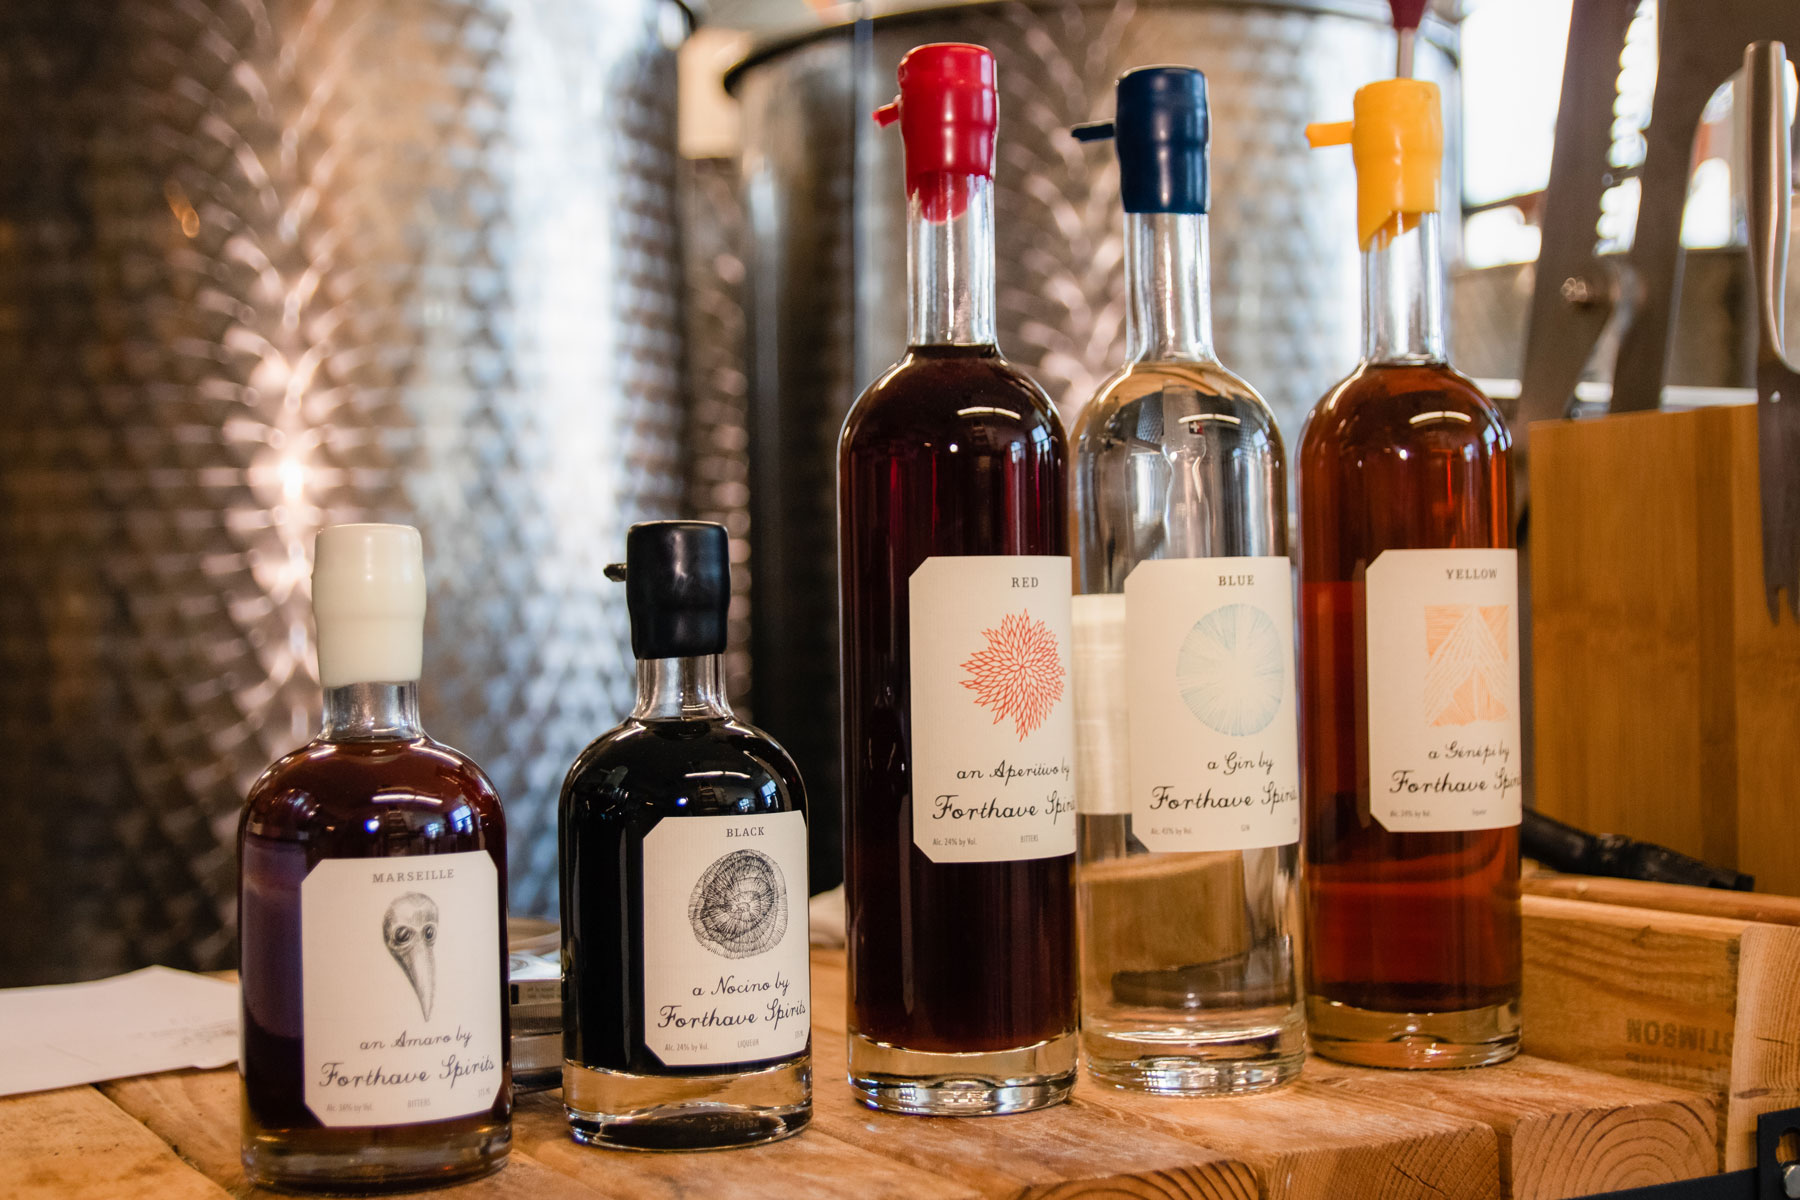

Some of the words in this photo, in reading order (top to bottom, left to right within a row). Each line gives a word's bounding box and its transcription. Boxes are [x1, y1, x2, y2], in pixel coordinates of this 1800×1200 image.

[1011, 576, 1039, 588] RED
[1218, 575, 1255, 587] BLUE
[1446, 568, 1498, 580] YELLOW
[1207, 759, 1219, 771] a
[1223, 751, 1255, 775] Gin
[1258, 751, 1274, 774] by
[1428, 750, 1439, 760] a
[1499, 739, 1510, 763] by
[956, 767, 984, 780] an
[989, 760, 1059, 786] Aperitivo
[1389, 769, 1488, 794] Forthave
[932, 794, 1039, 820] Forthave
[1149, 785, 1253, 810] Forthave
[726, 826, 765, 838] BLACK
[932, 838, 943, 846] Alc.
[944, 838, 957, 846] 24%
[959, 838, 966, 848] by
[967, 837, 977, 846] Vol.
[1020, 834, 1039, 843] BITTERS
[372, 868, 455, 884] MARSEILLE
[692, 985, 705, 996] a
[711, 976, 770, 996] Nocino
[775, 971, 790, 996] by
[657, 1004, 758, 1029] Forthave
[764, 998, 806, 1031] Spirits
[360, 1040, 385, 1050] an
[391, 1030, 451, 1048] Amaro
[456, 1025, 472, 1048] by
[664, 1043, 675, 1052] Alc.
[676, 1043, 689, 1052] 24%
[691, 1043, 698, 1053] by
[699, 1043, 709, 1051] Vol.
[737, 1038, 760, 1049] LIQUEUR
[318, 1062, 430, 1088] Forthave
[439, 1054, 495, 1089] Spirits
